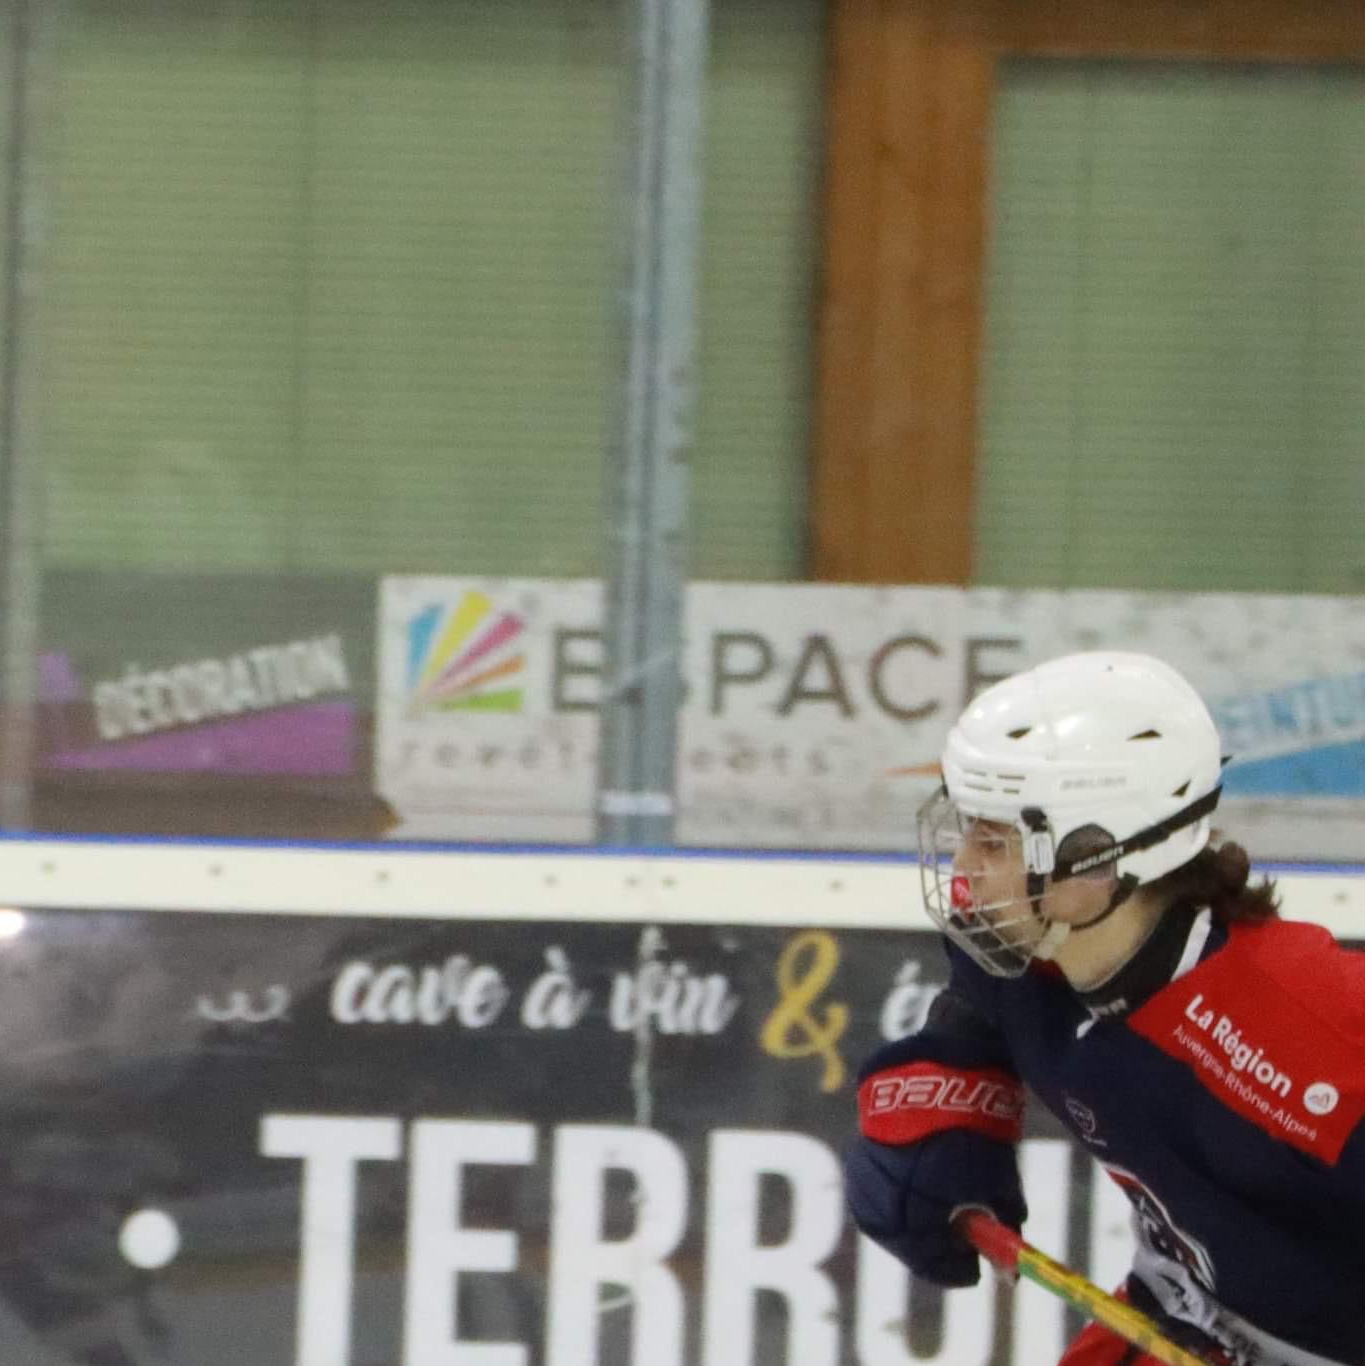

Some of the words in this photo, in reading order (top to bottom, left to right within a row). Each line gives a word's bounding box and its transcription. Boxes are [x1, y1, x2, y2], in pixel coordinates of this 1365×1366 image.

[549, 627, 1023, 722] EPACE
[332, 951, 508, 1028] cave
[522, 945, 590, 1030] à
[609, 955, 741, 1035] vin
[759, 929, 847, 1093] &
[1184, 993, 1215, 1032] La
[1211, 1014, 1293, 1098] Région
[867, 1074, 1021, 1120] BAUE
